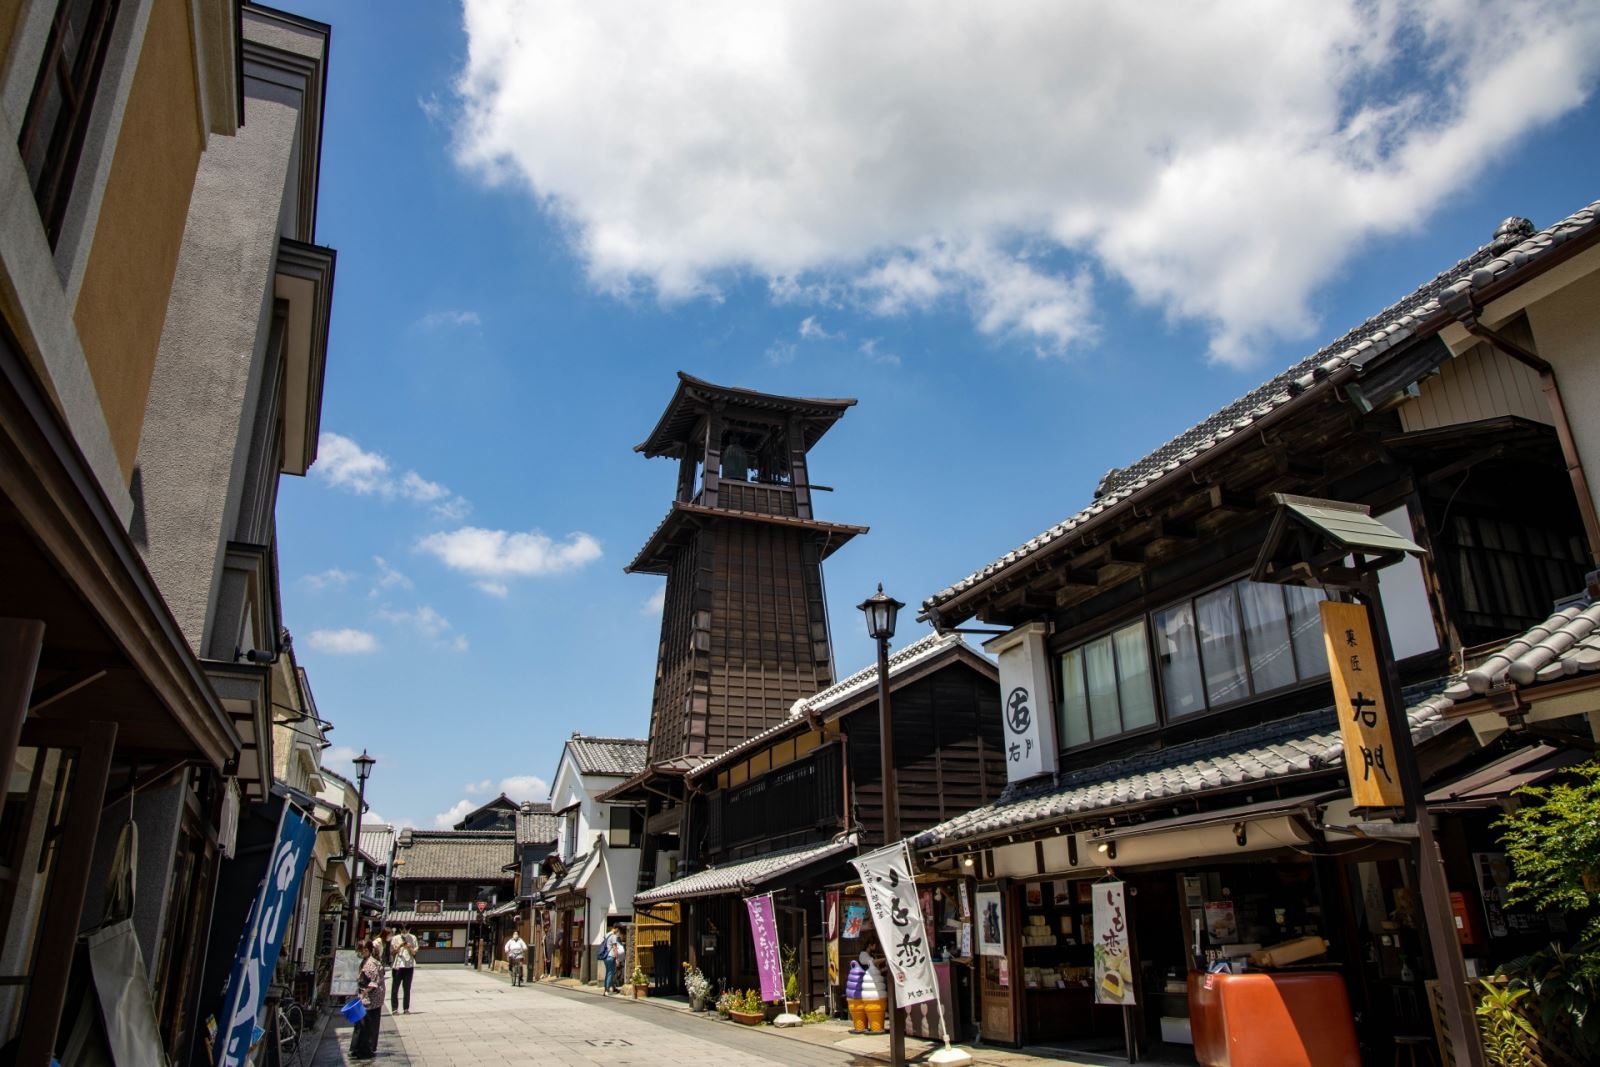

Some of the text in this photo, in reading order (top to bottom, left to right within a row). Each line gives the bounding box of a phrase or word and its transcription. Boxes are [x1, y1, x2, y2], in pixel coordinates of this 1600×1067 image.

[1009, 692, 1030, 729] 右
[1008, 738, 1034, 762] 右門
[1351, 692, 1392, 783] 右門
[1102, 889, 1123, 957] いも恋
